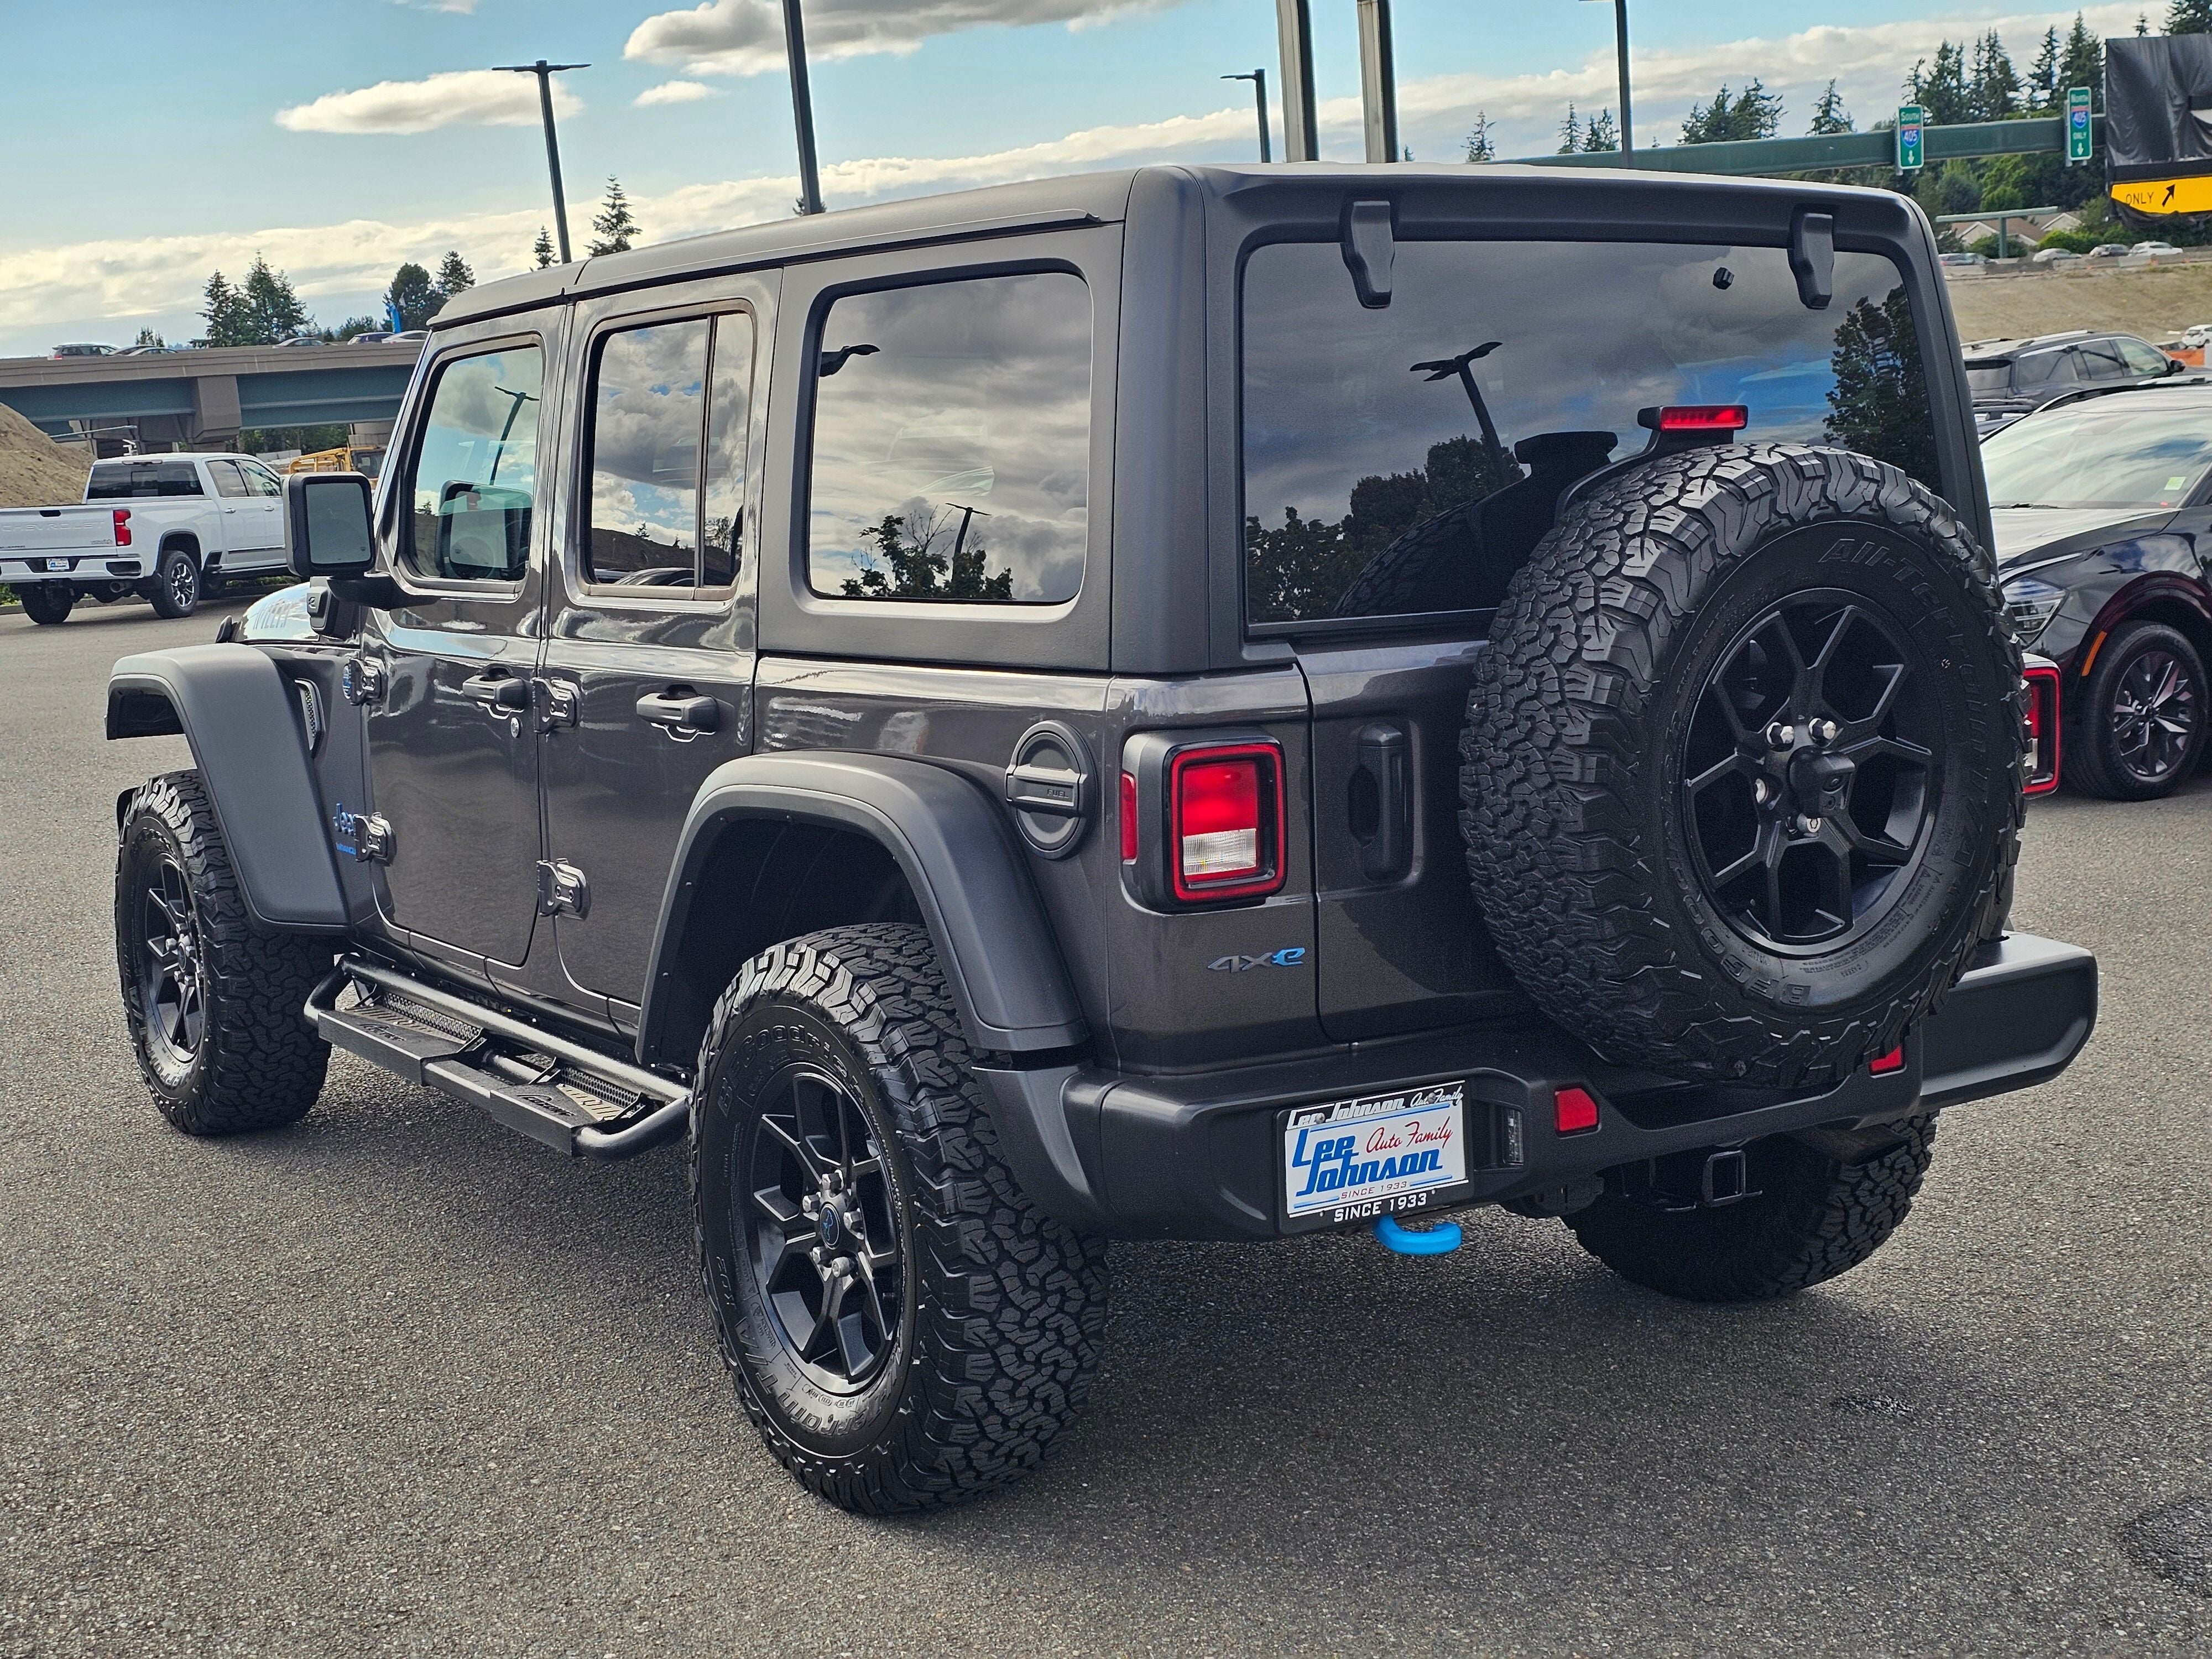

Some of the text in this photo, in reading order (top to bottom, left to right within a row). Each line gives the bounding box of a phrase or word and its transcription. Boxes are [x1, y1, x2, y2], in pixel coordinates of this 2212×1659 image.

[2074, 111, 2086, 122] 405
[1904, 130, 1918, 142] 405
[2126, 191, 2154, 205] ONLY
[2, 521, 106, 532] CHEVROLET
[1047, 789, 1069, 799] FUEL
[1326, 1098, 1405, 1123] Johnson
[1434, 1085, 1464, 1105] Family
[1292, 1115, 1453, 1167] Lee Auto Family
[1295, 1148, 1443, 1197] Johnson
[1340, 1181, 1407, 1199] SINCE 1933
[1334, 1193, 1427, 1223] SINCE 1933
